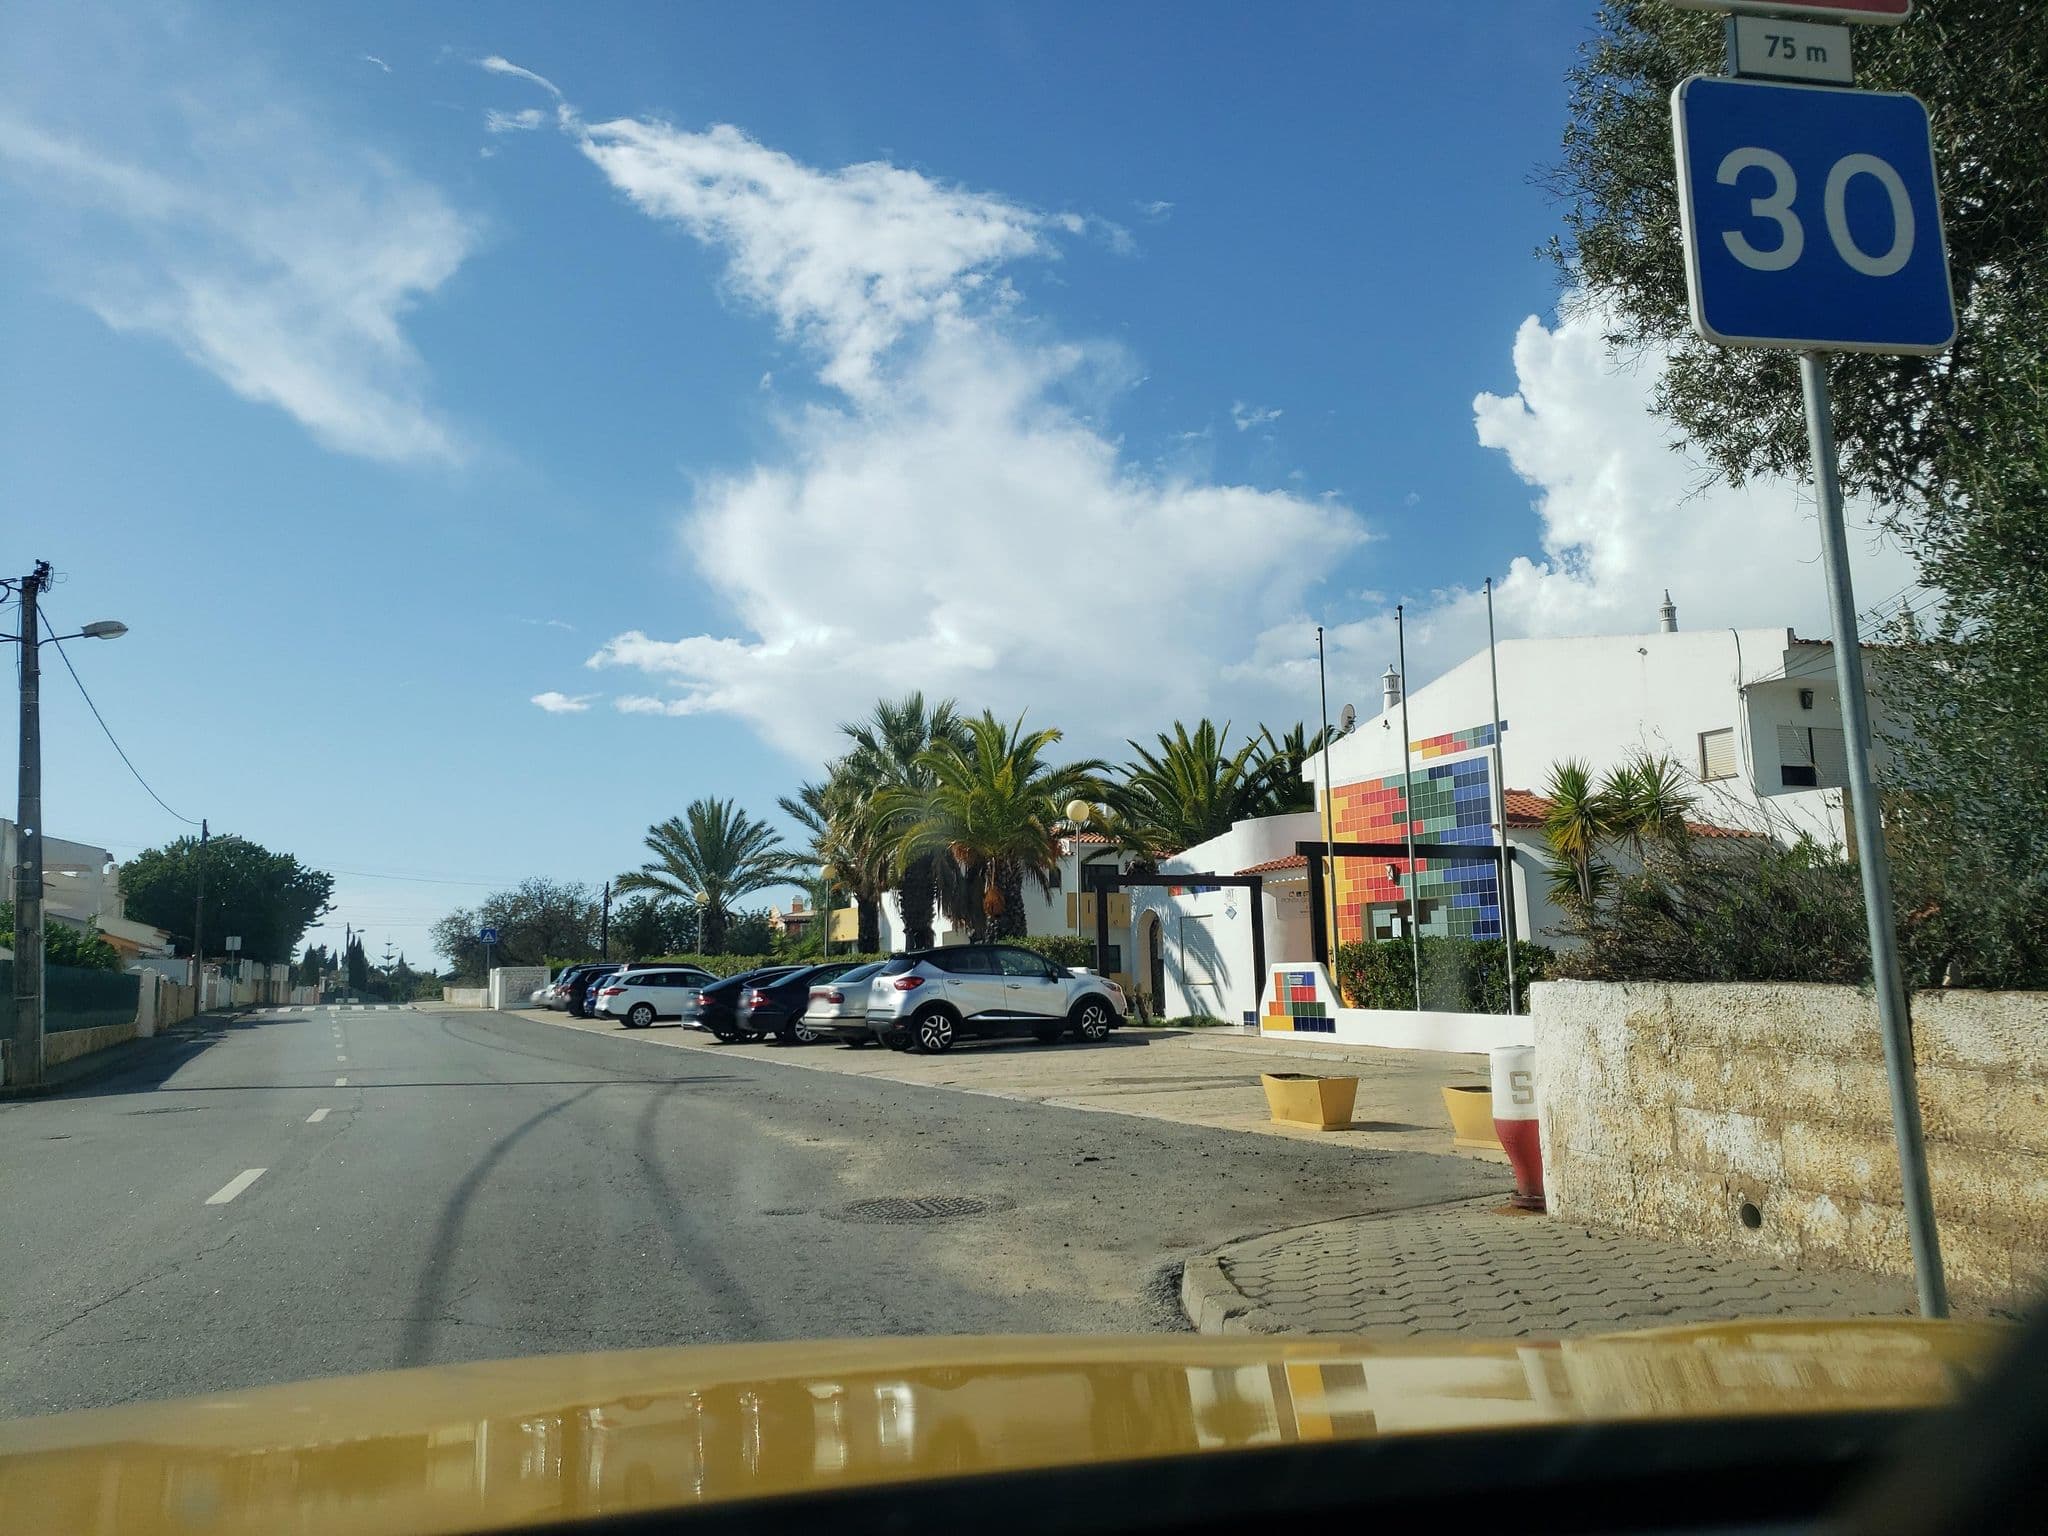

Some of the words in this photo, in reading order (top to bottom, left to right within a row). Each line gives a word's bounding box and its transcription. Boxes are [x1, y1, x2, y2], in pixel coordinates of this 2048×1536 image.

[1765, 35, 1796, 59] 75
[1807, 46, 1827, 63] m
[1717, 147, 1915, 277] 30
[1510, 1071, 1534, 1104] S
